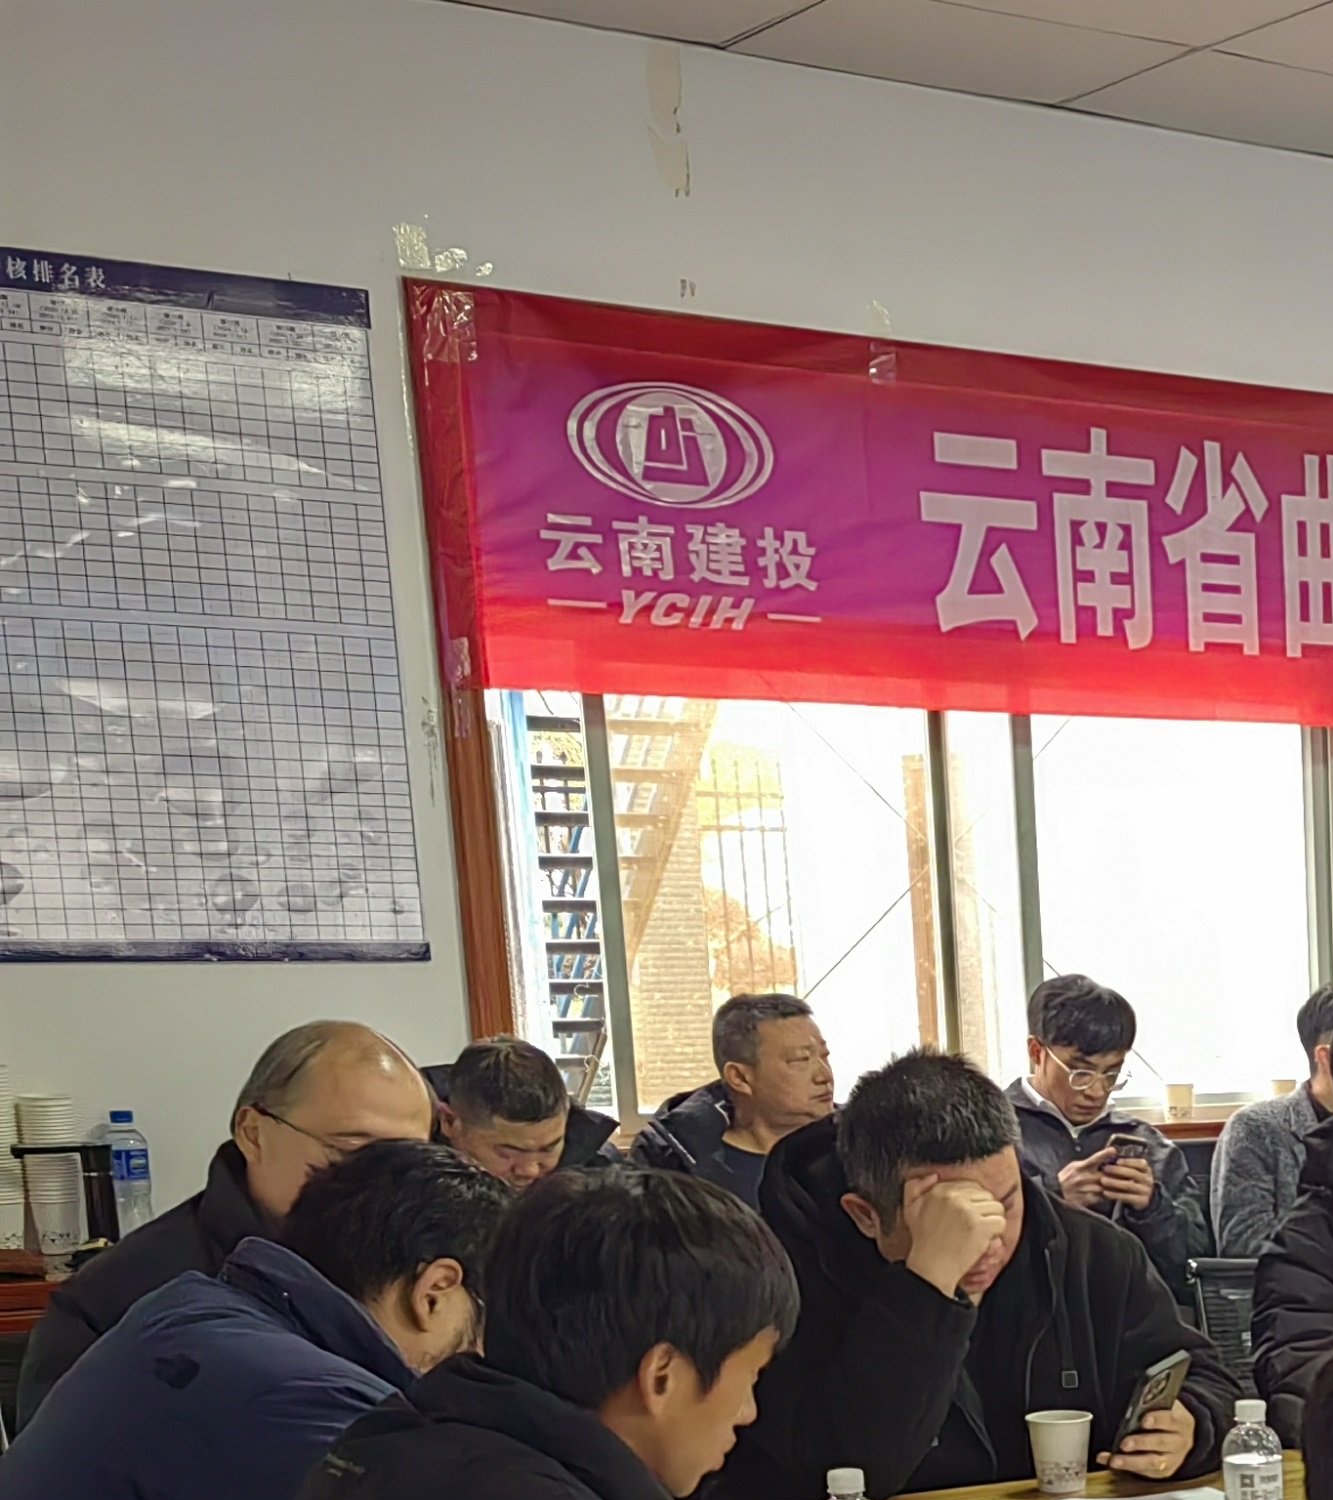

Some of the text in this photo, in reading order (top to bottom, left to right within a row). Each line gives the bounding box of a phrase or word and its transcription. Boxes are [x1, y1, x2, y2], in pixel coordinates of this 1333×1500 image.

[6, 255, 106, 289] 核排名表
[540, 513, 818, 591] 云南建投
[618, 589, 755, 631] YCIH
